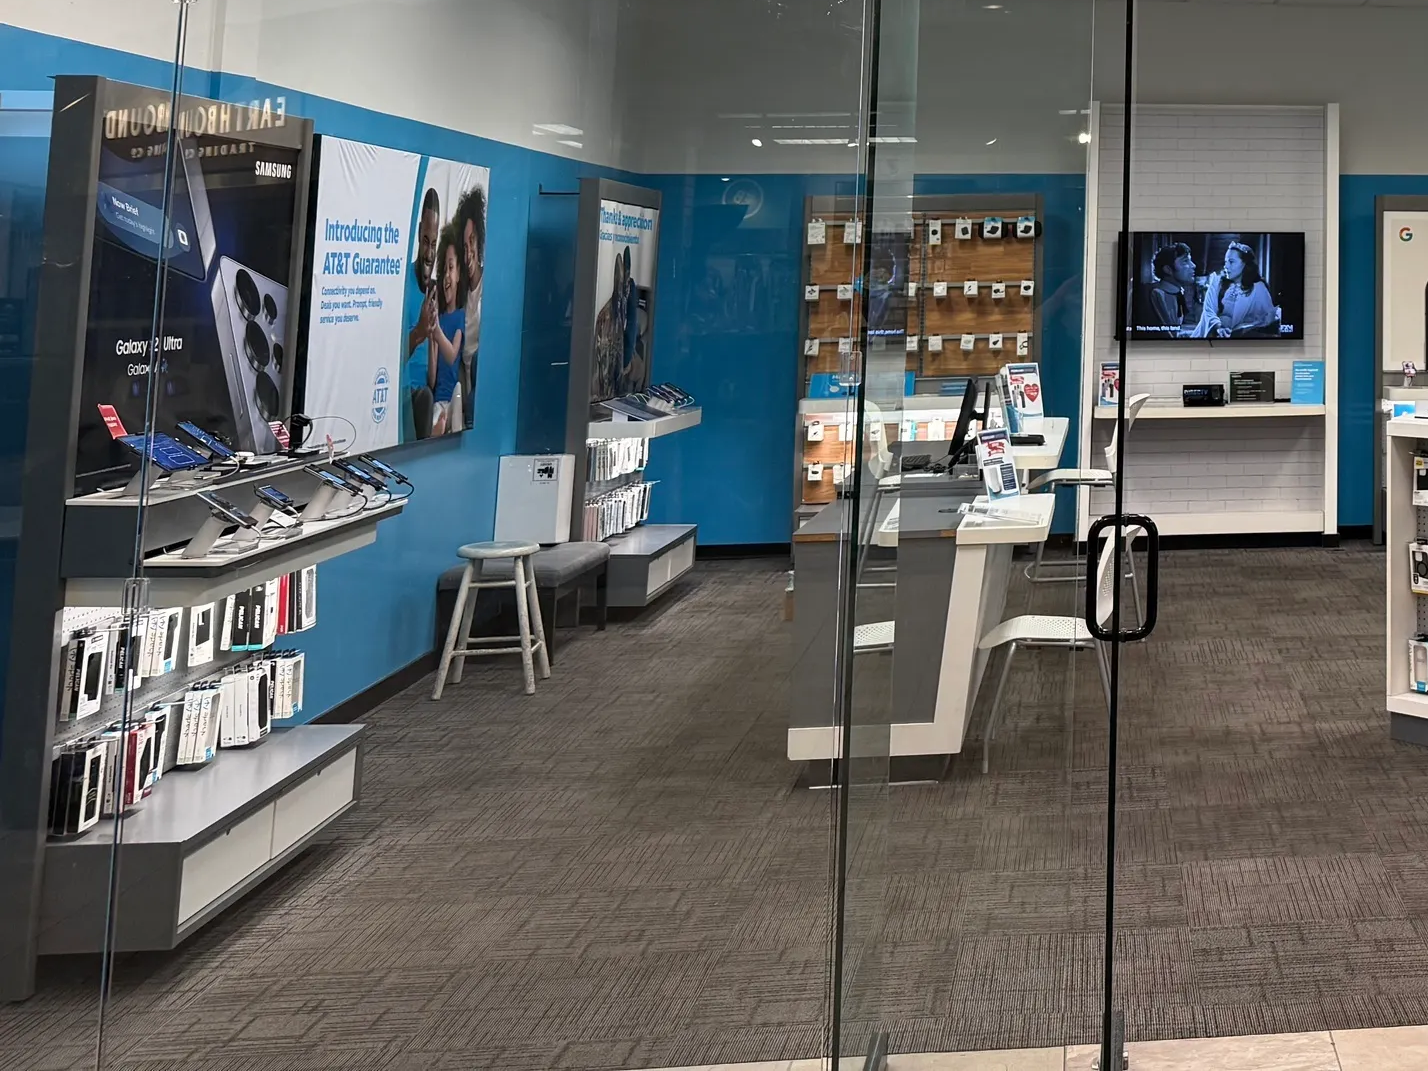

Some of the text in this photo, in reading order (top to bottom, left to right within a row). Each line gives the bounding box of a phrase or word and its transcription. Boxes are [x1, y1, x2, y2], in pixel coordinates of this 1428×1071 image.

[255, 160, 292, 179] SAMSUNG
[325, 218, 400, 249] Introducing the
[322, 252, 351, 275] AT&T
[116, 339, 148, 357] Galaxy
[163, 335, 183, 351] Ultra
[127, 363, 150, 376] Galax
